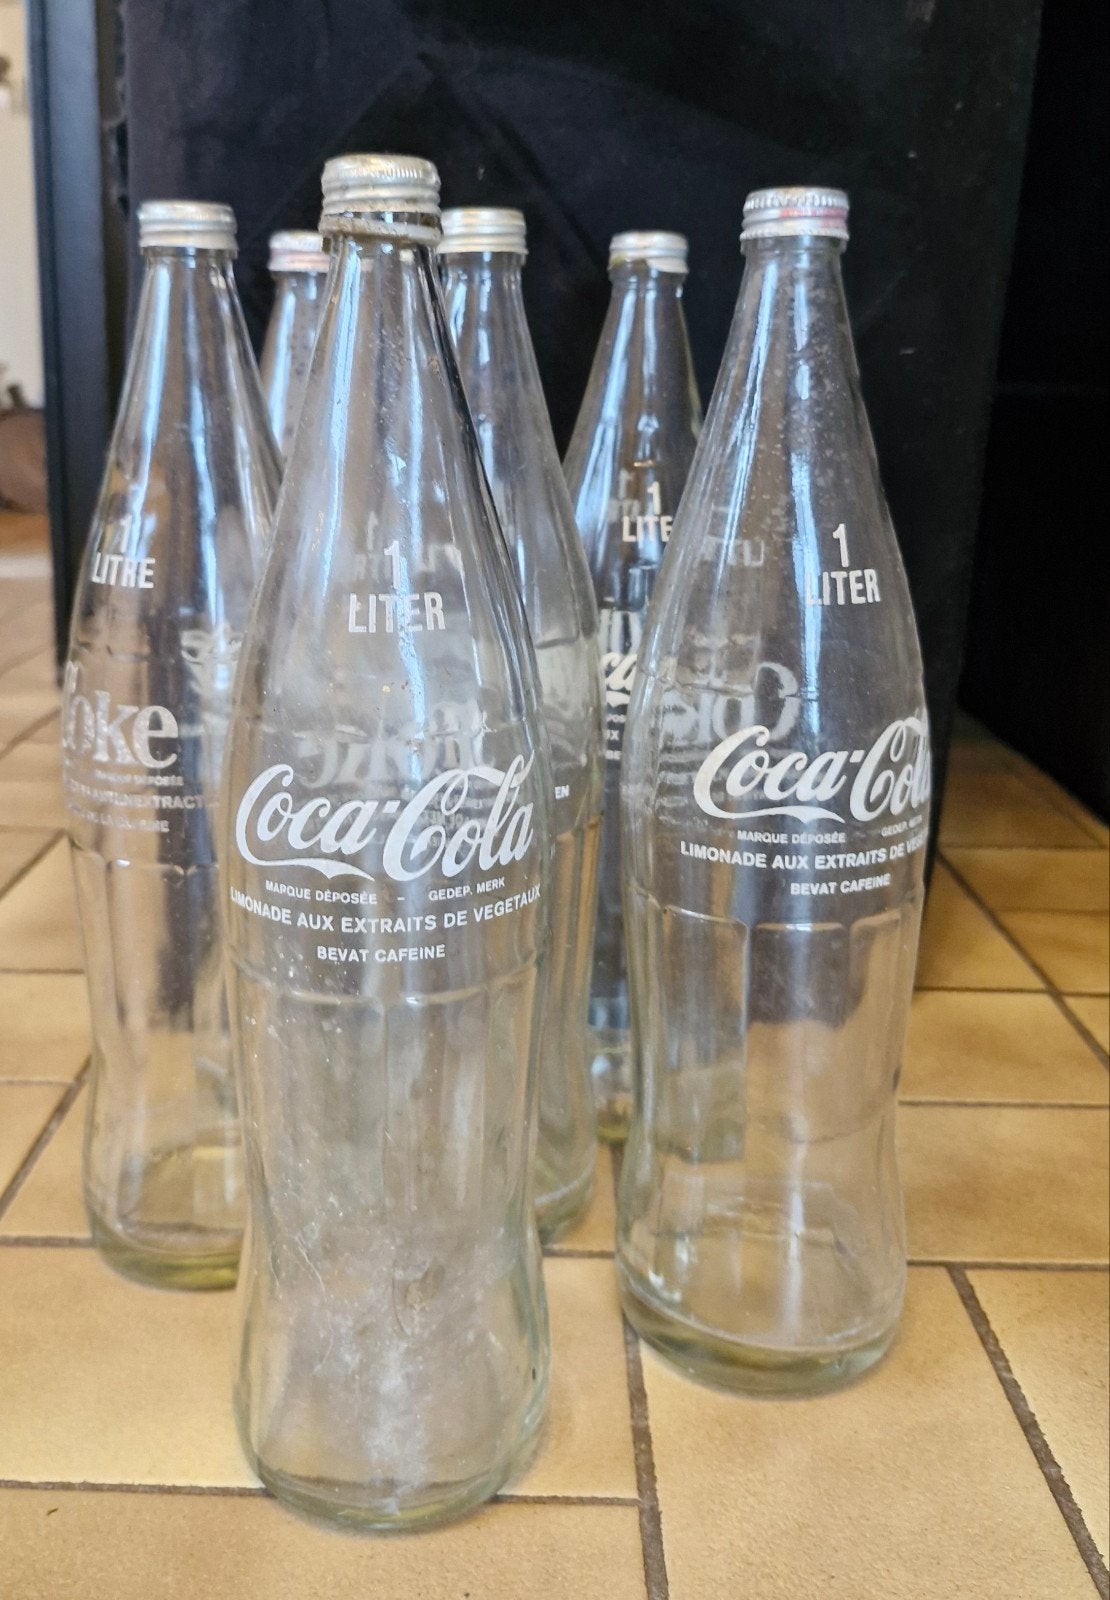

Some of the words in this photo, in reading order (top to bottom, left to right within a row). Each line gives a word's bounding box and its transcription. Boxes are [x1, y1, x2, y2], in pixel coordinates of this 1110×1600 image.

[647, 481, 661, 515] 1
[622, 515, 673, 542] LITE
[832, 523, 849, 568] 1
[91, 552, 156, 589] LITRE
[384, 539, 401, 590] 1
[805, 568, 881, 606] LITER
[348, 591, 446, 634] LITER
[235, 749, 534, 882] Coca-Cola
[680, 840, 767, 869] LIMONADE
[772, 854, 809, 870] AUX
[814, 847, 887, 870] EXTRAITS
[889, 842, 905, 861] DE
[737, 830, 788, 845] MARQUE
[265, 880, 311, 900] MARQUE
[428, 885, 473, 901] GEDEP.
[476, 876, 506, 894] MERK
[790, 882, 837, 896] BEVAT
[839, 873, 891, 894] CAFEINE
[230, 886, 292, 926] LIMONADE
[297, 912, 335, 932] AUX
[341, 914, 437, 934] EXTRAITS
[443, 910, 468, 929] DE
[473, 883, 541, 923] VEGETAUX
[317, 945, 369, 963] BEVAT
[374, 943, 446, 963] CAFEINE
